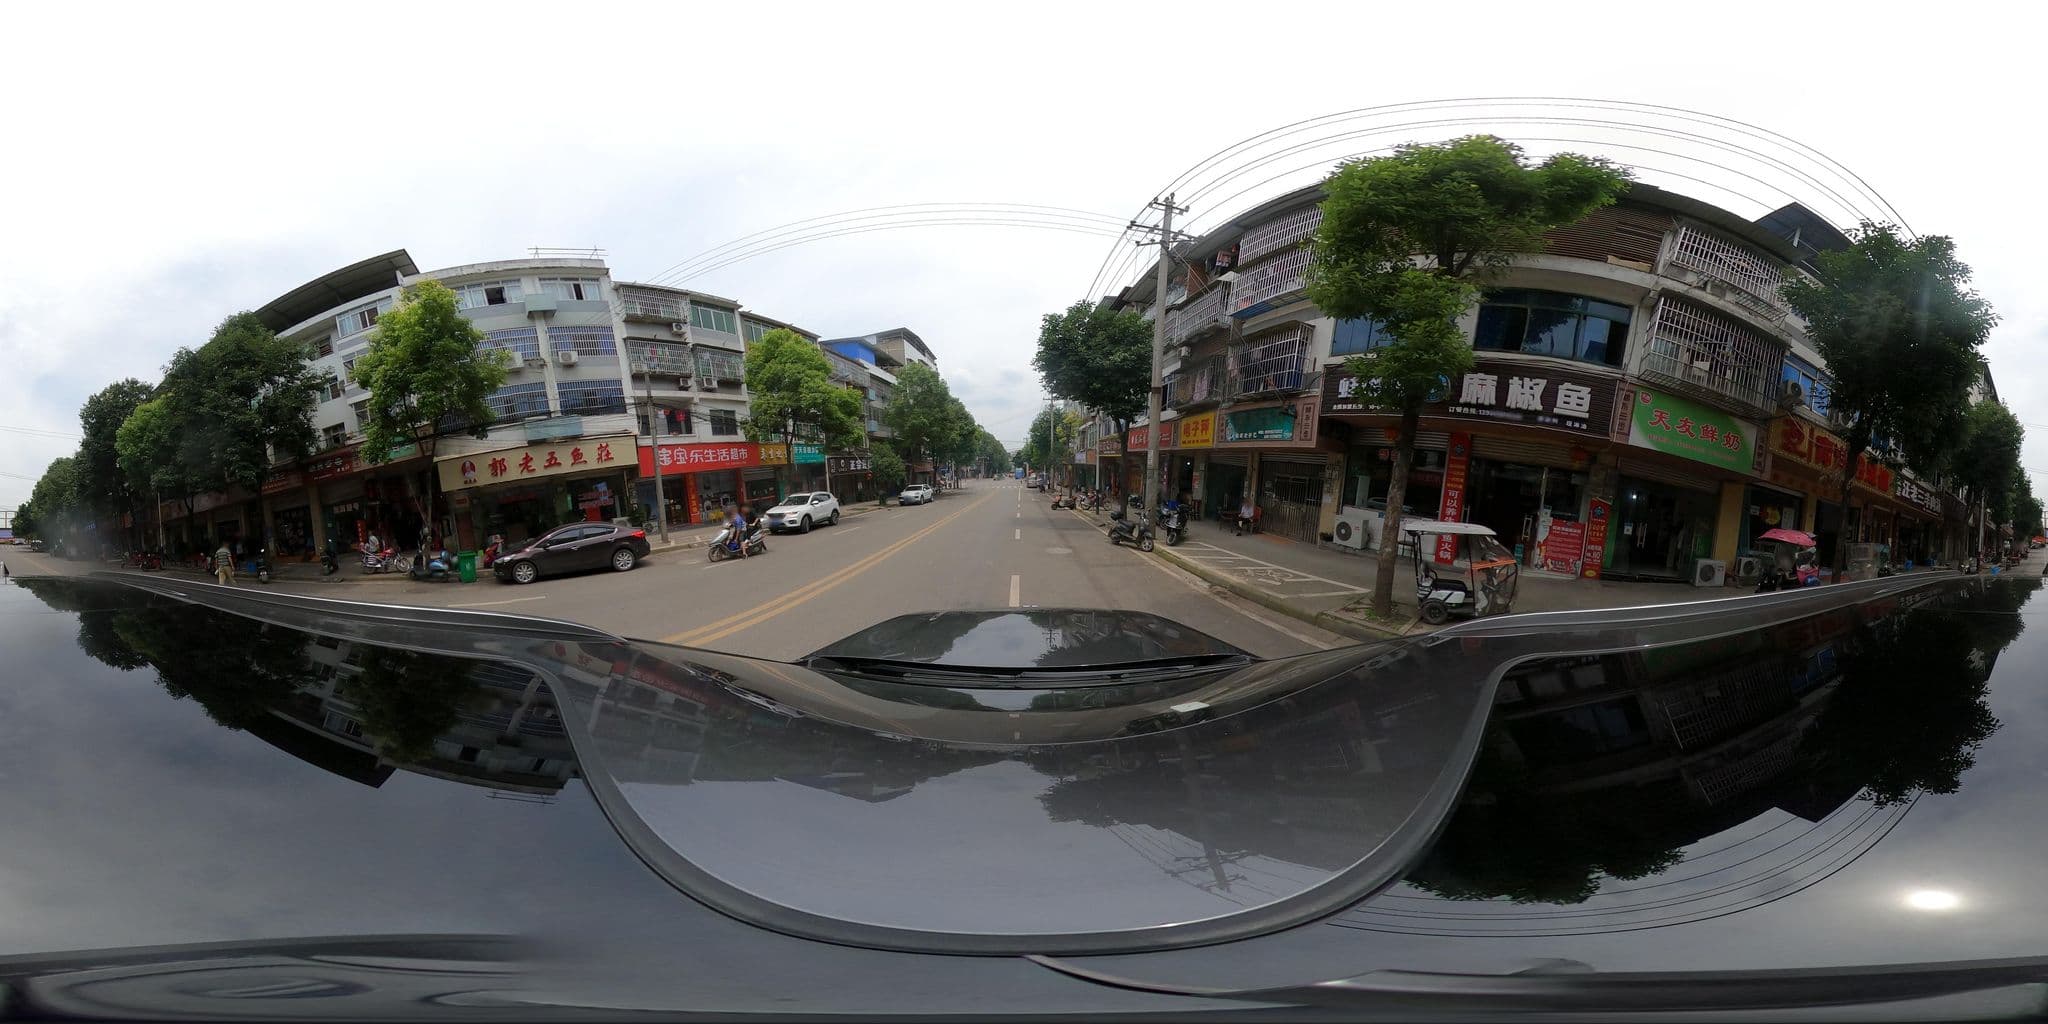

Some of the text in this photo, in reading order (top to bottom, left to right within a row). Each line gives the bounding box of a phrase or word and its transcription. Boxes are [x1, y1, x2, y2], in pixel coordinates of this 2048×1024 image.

[1459, 373, 1592, 419] 麻椒鱼
[1183, 418, 1210, 438] 电子秤
[1648, 409, 1741, 452] 天友鲜奶
